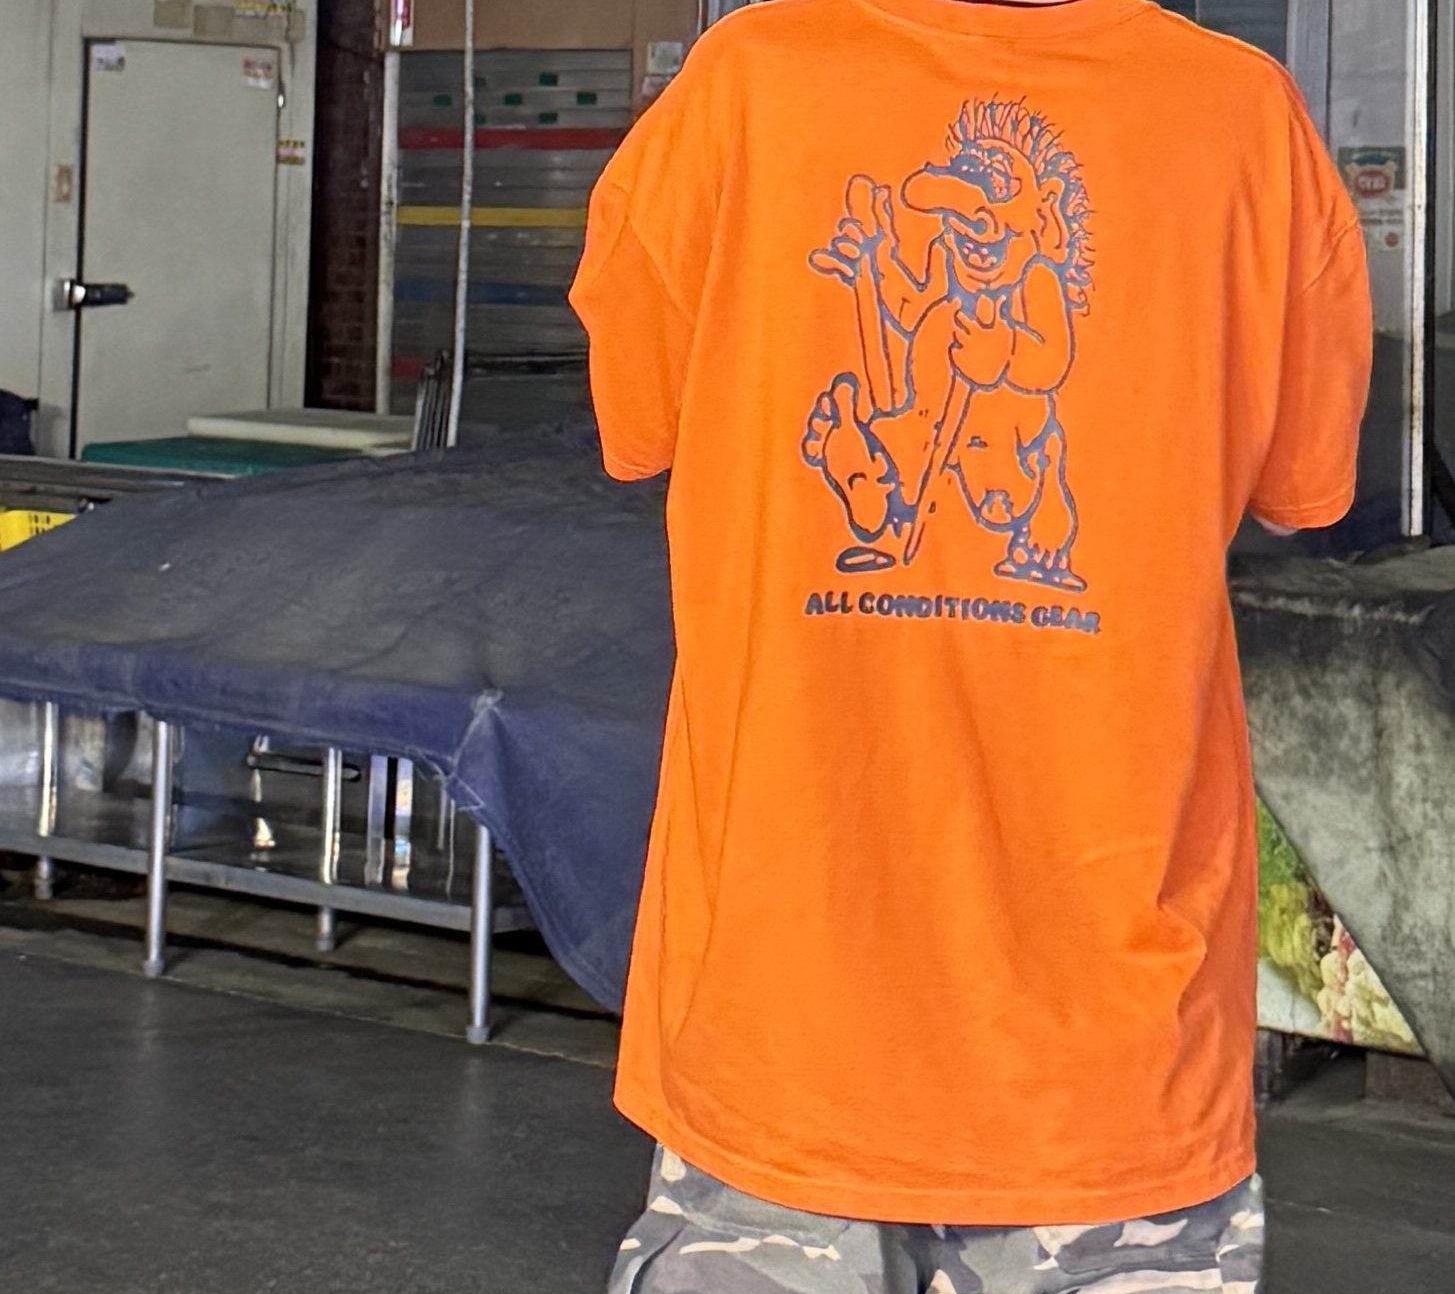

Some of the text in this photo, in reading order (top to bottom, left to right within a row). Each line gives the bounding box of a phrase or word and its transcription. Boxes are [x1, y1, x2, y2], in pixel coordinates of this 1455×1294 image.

[804, 592, 1102, 635] ALL CONDITIONS GEAR
